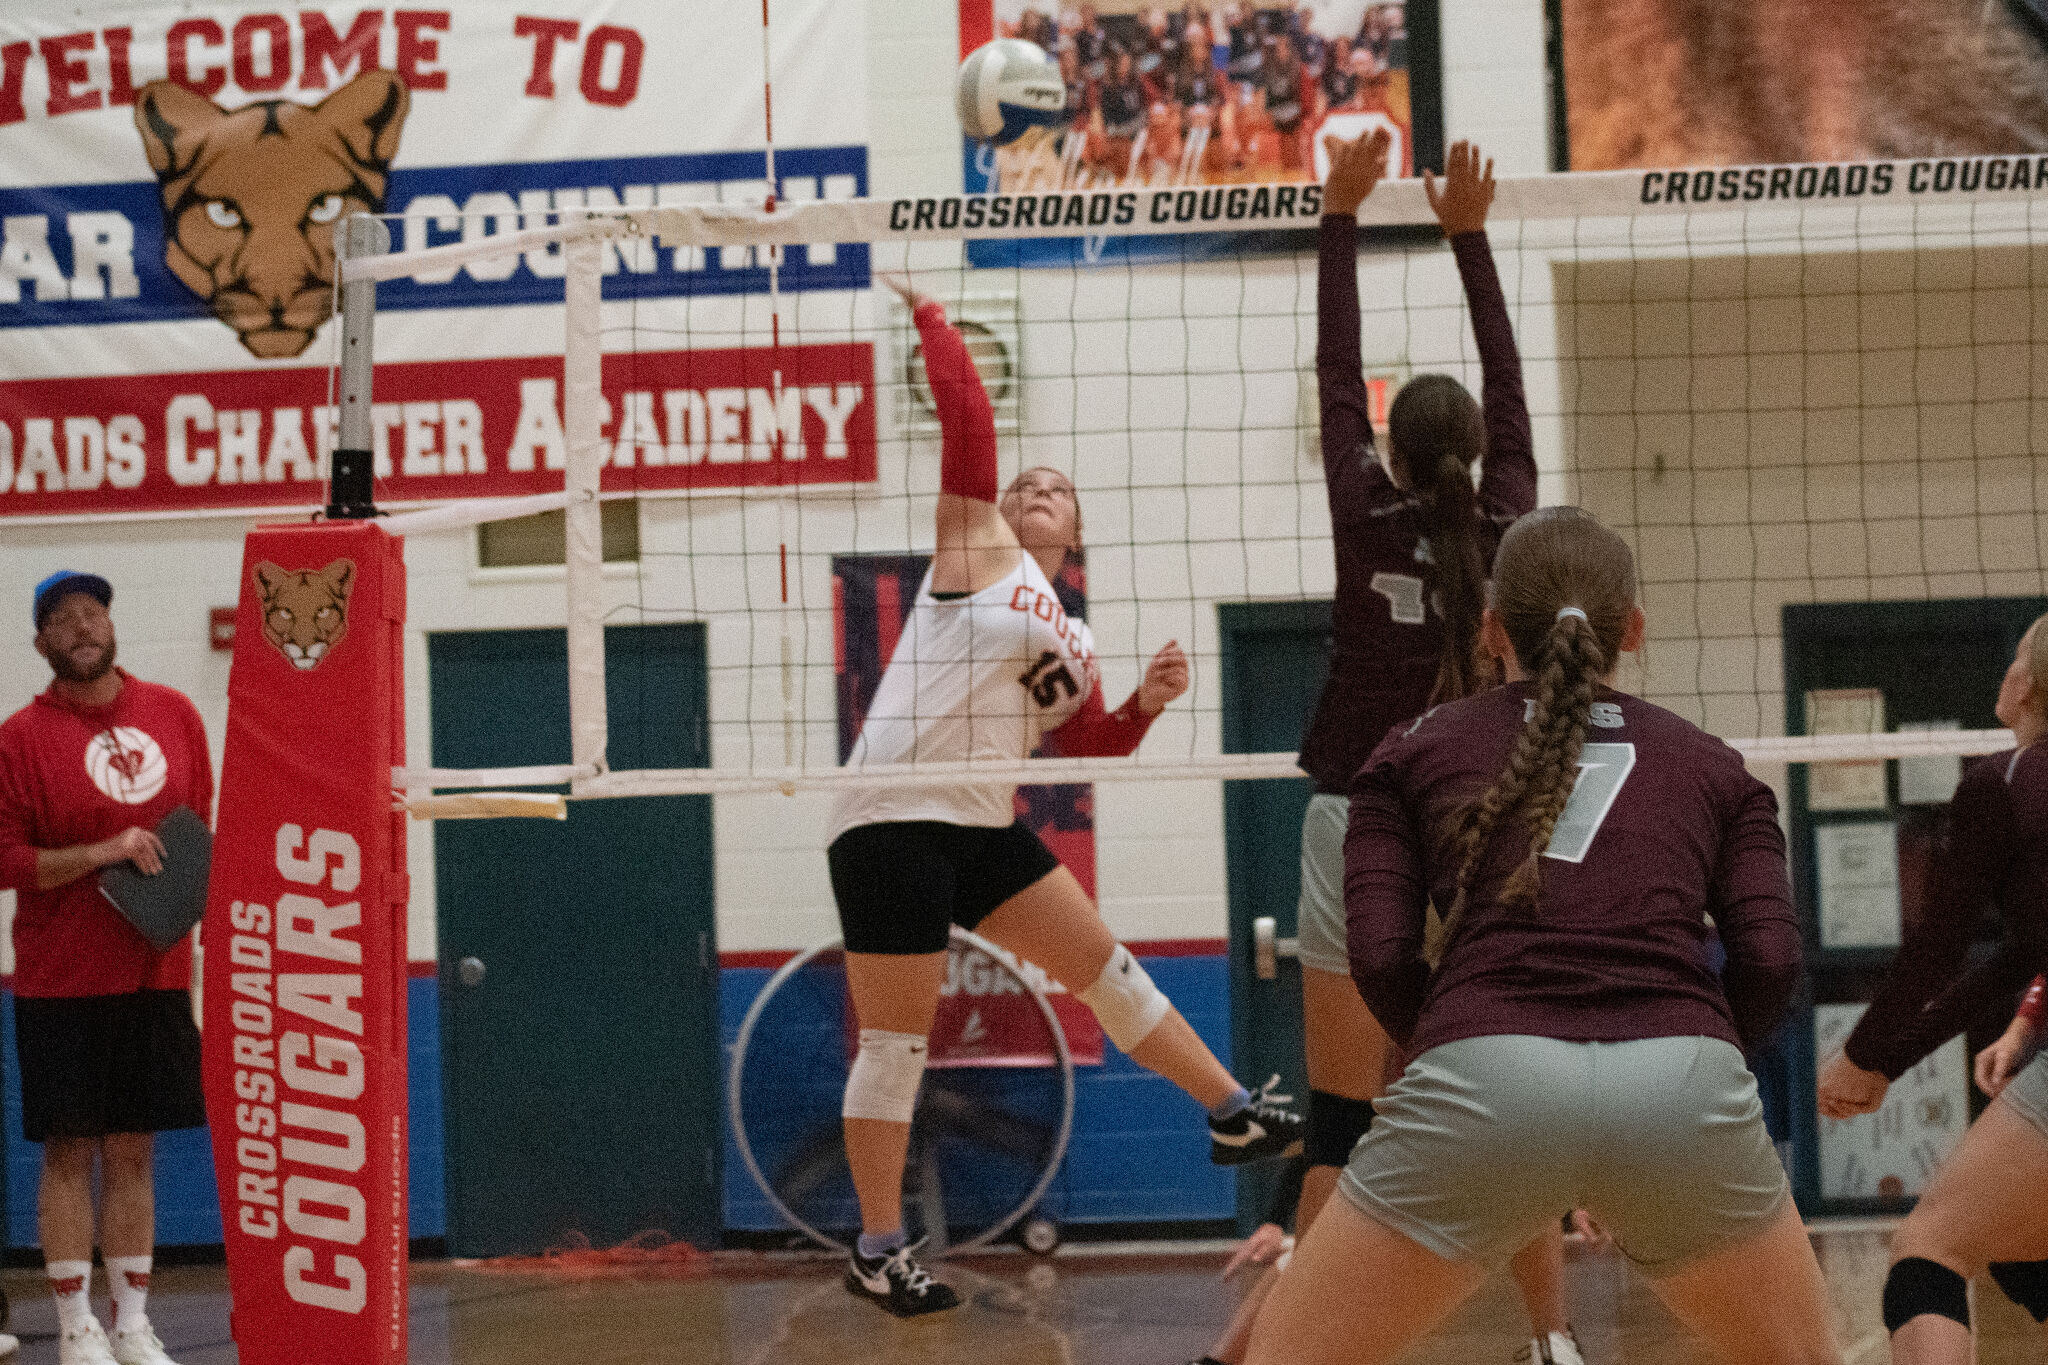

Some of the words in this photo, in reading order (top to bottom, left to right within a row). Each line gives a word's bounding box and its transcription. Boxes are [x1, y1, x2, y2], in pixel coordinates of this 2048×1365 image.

[514, 15, 645, 108] TO
[889, 192, 1137, 231] CROSSROADS
[1150, 185, 1323, 223] COUGARS
[1639, 163, 1894, 204] CROSSROADS
[1019, 651, 1079, 708] 15
[1540, 742, 1637, 864] 7
[229, 900, 279, 1240] CROSSROADS
[275, 822, 367, 1314] COUGARS
